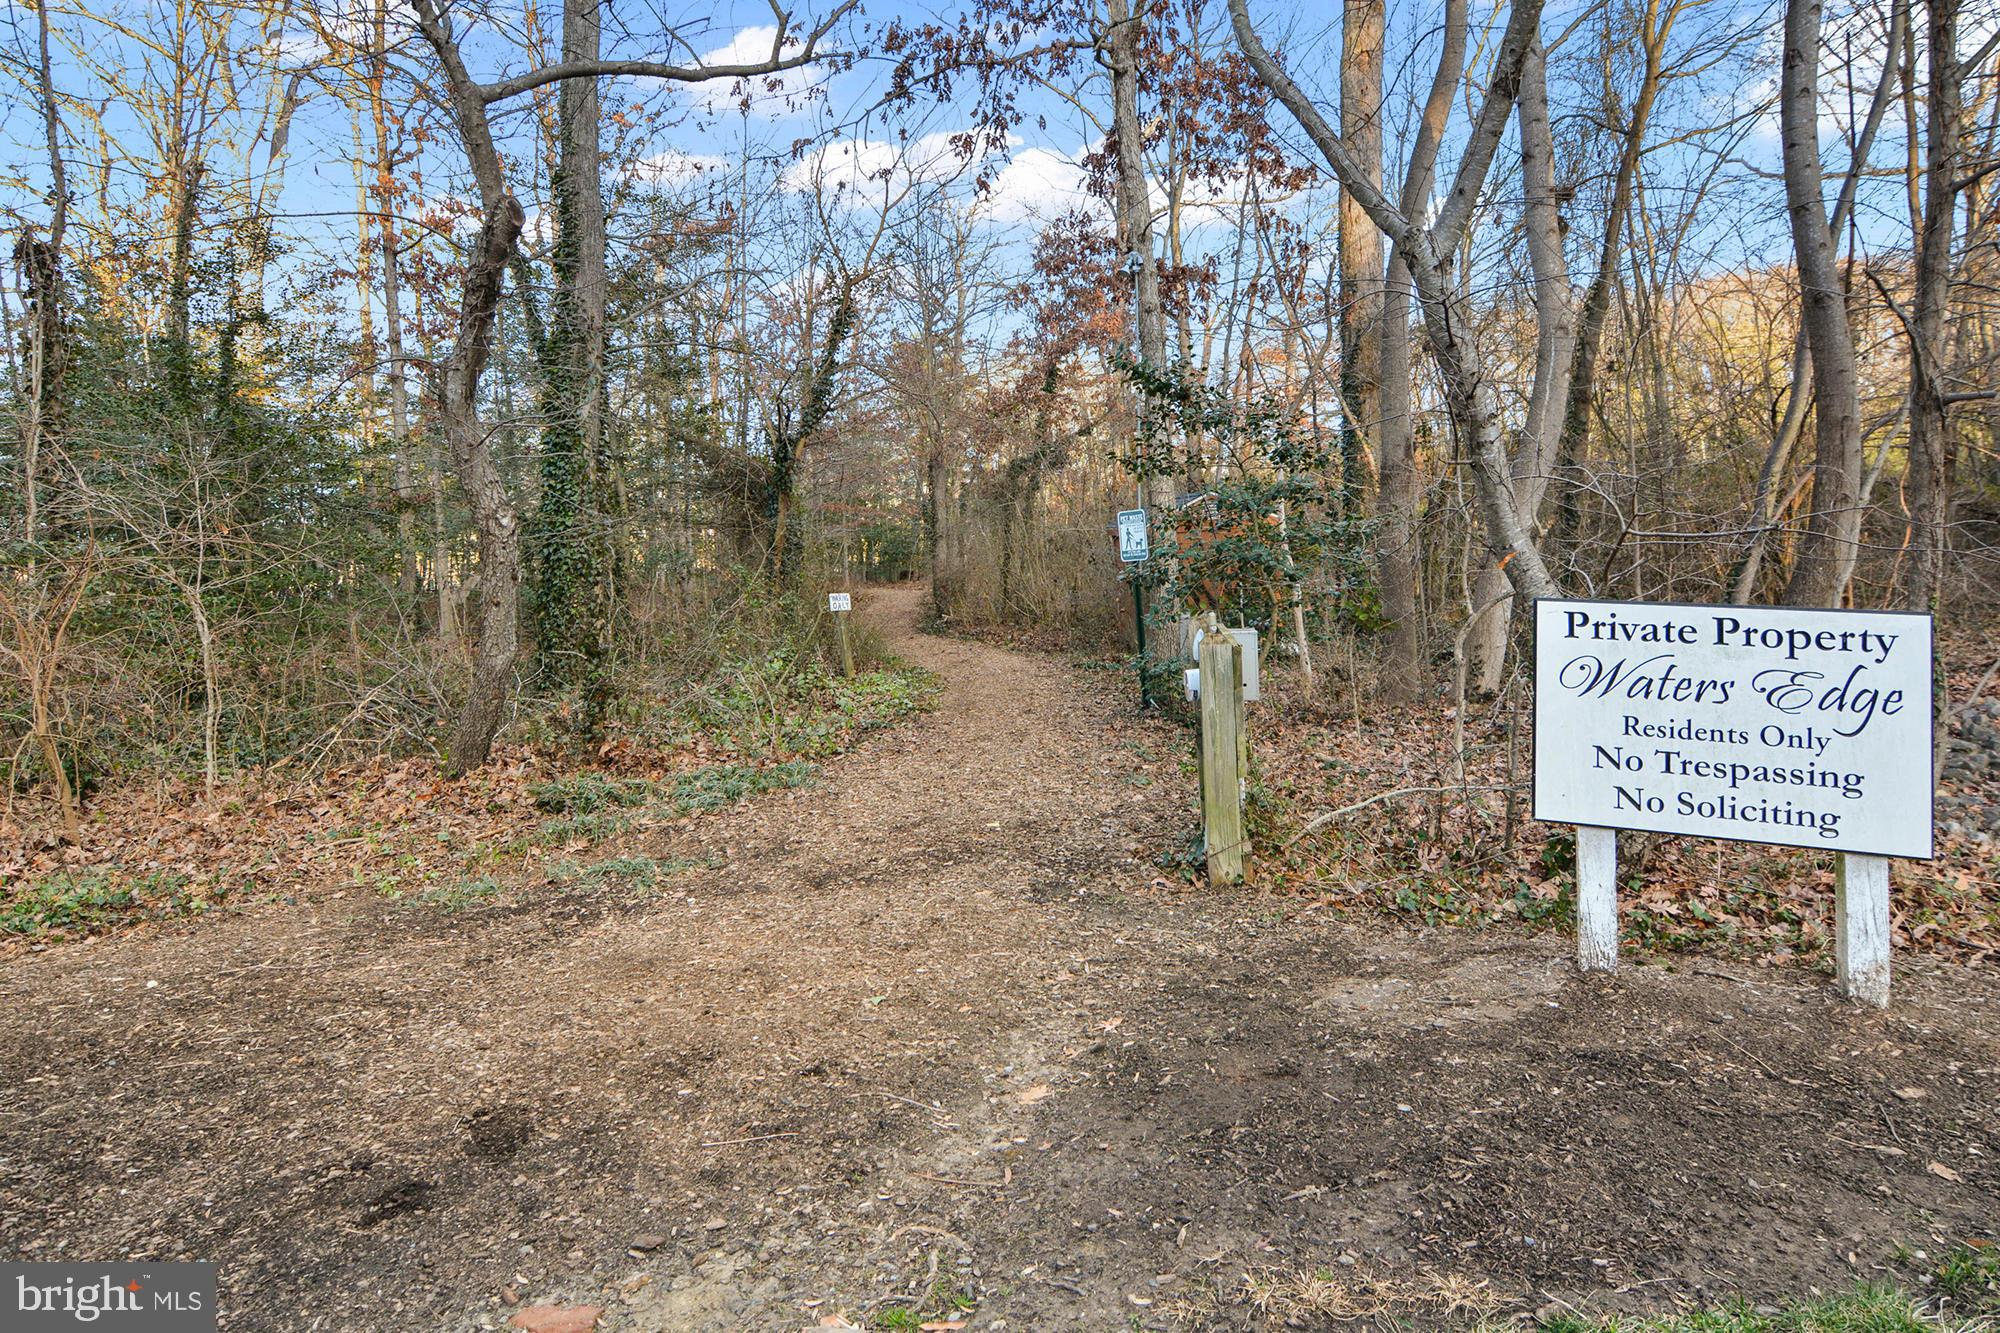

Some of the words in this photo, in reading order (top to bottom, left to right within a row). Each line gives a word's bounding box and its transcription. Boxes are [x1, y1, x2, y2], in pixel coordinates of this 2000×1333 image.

[1563, 611, 1698, 645] Private
[1712, 616, 1900, 664] Property
[1559, 654, 1735, 705] Waters
[1752, 664, 1904, 738] Edge
[1622, 714, 1750, 745] Residents
[1759, 724, 1832, 758] Only
[1592, 744, 1644, 772] No
[1654, 749, 1865, 800] Trespassing
[1613, 785, 1665, 814] No
[1676, 791, 1841, 839] Soliciting
